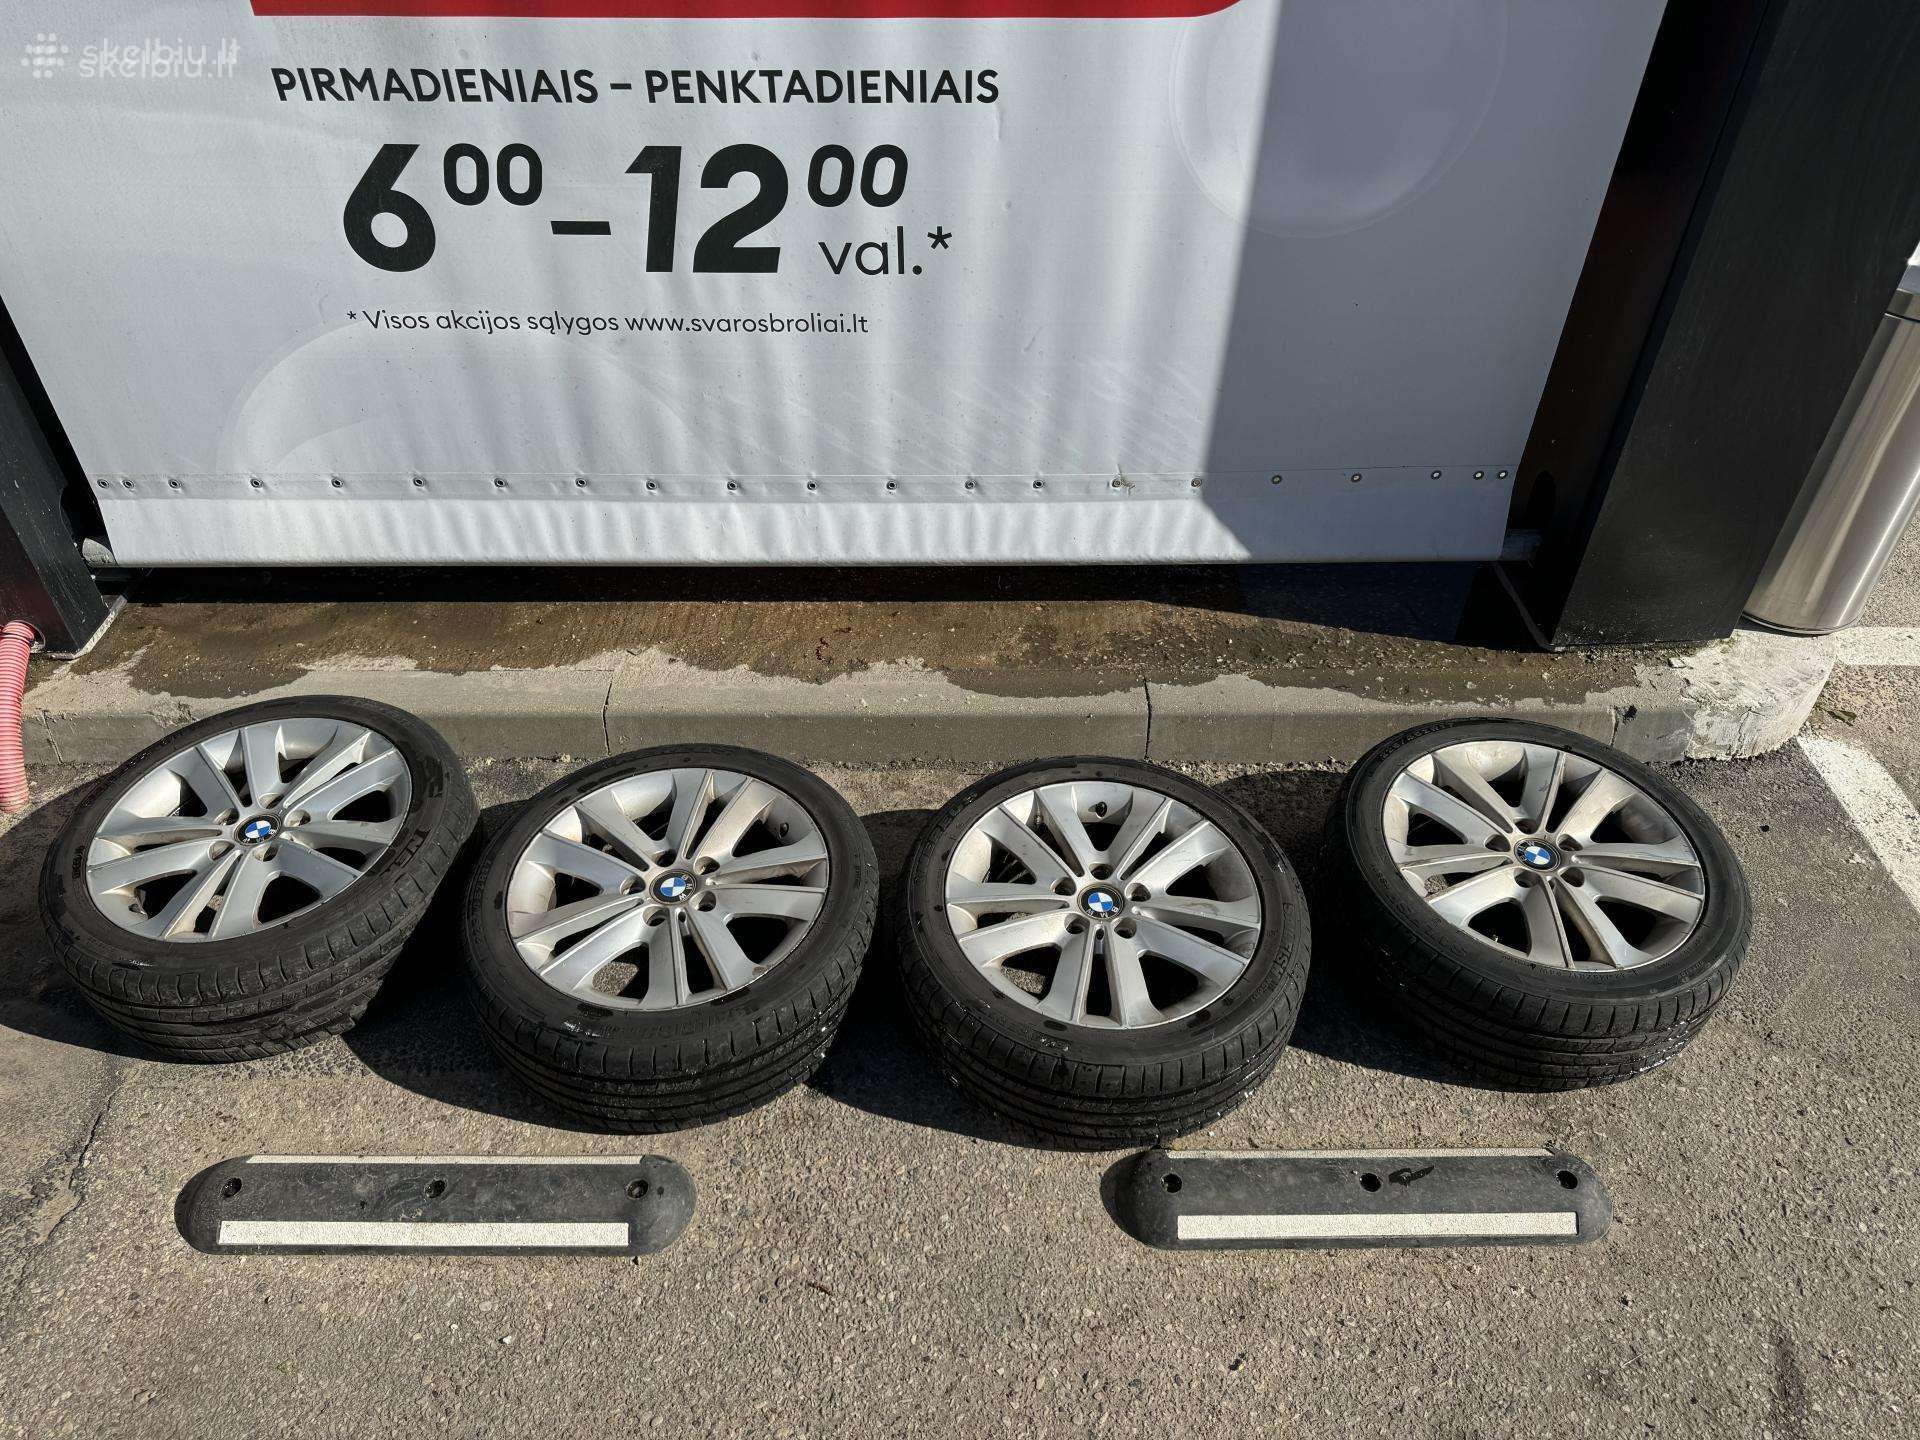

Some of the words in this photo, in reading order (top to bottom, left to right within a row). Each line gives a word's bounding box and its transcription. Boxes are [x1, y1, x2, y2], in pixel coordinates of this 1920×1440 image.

[271, 67, 599, 104] PIRMADIENIAIS
[645, 69, 999, 104] PENKTADIENIAIS
[362, 310, 430, 330] Visos
[436, 309, 521, 335] akcijos
[527, 310, 619, 336] sąlygos
[624, 312, 869, 333] www.svarosbroliai.lt
